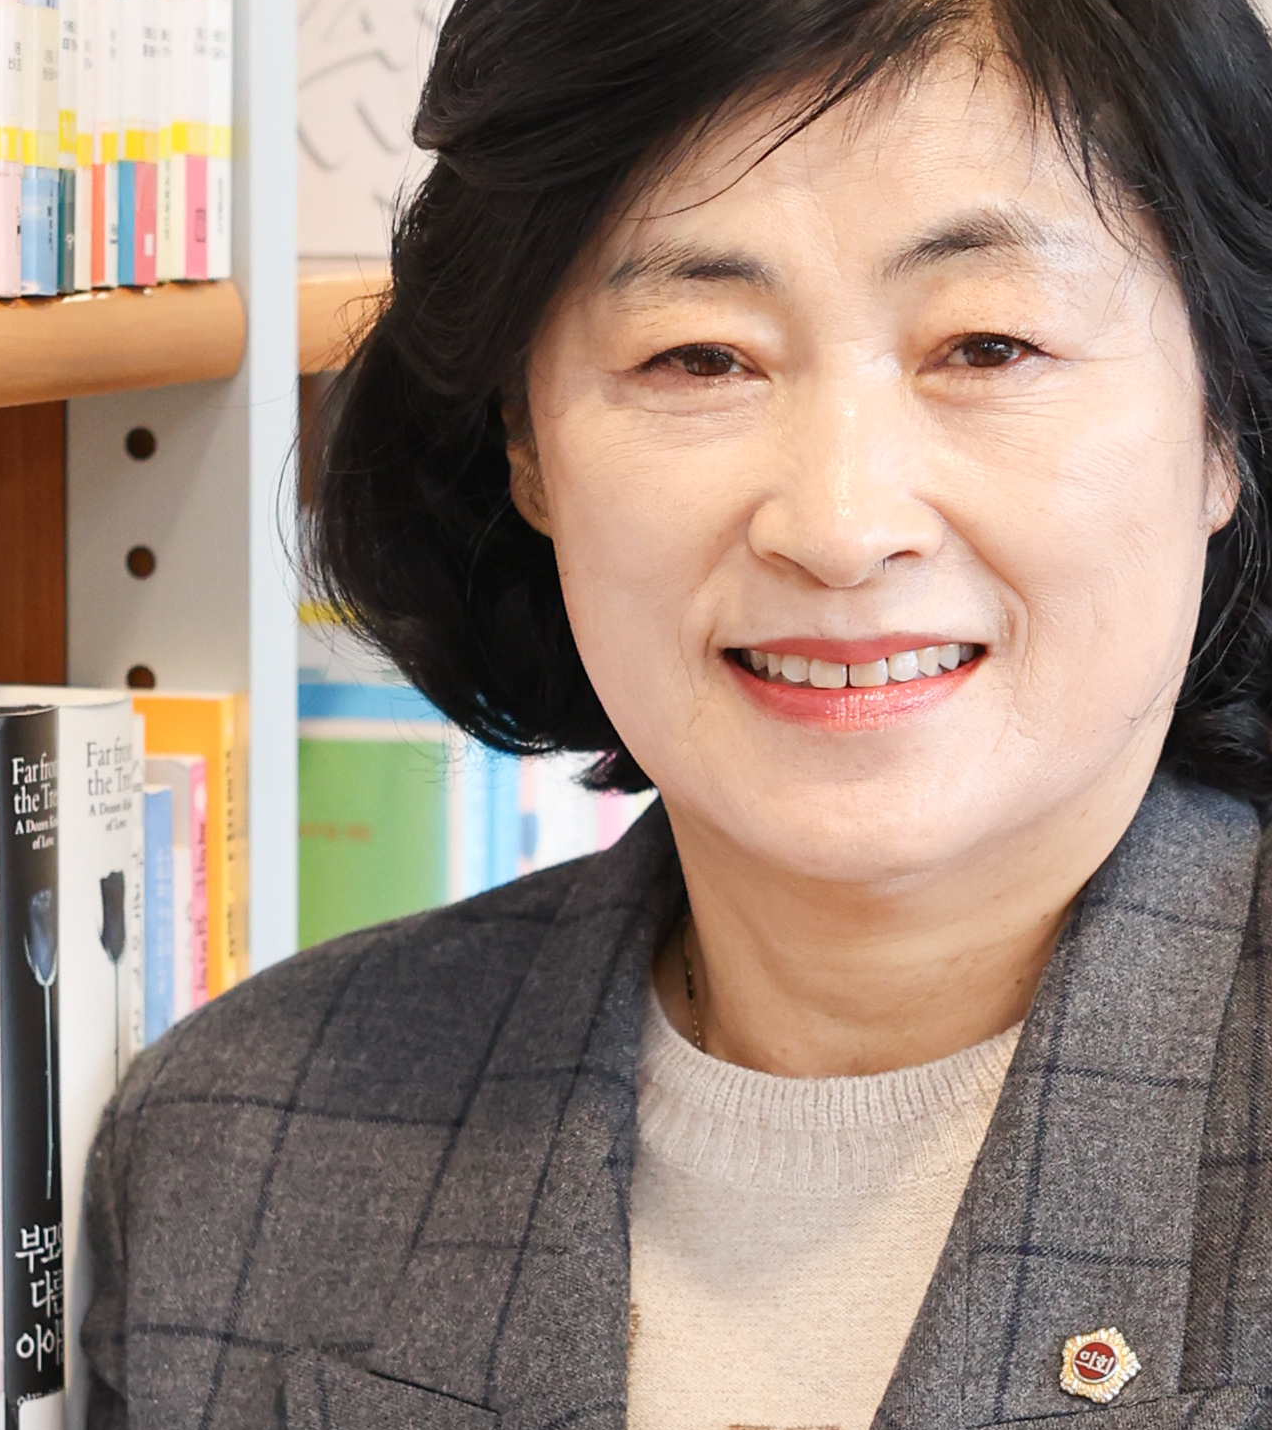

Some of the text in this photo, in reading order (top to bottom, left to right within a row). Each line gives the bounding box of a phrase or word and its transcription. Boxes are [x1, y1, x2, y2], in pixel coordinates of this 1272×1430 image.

[12, 755, 37, 787] Far
[14, 787, 38, 816] the
[14, 818, 24, 836] A
[1077, 1346, 1117, 1375] 의회
